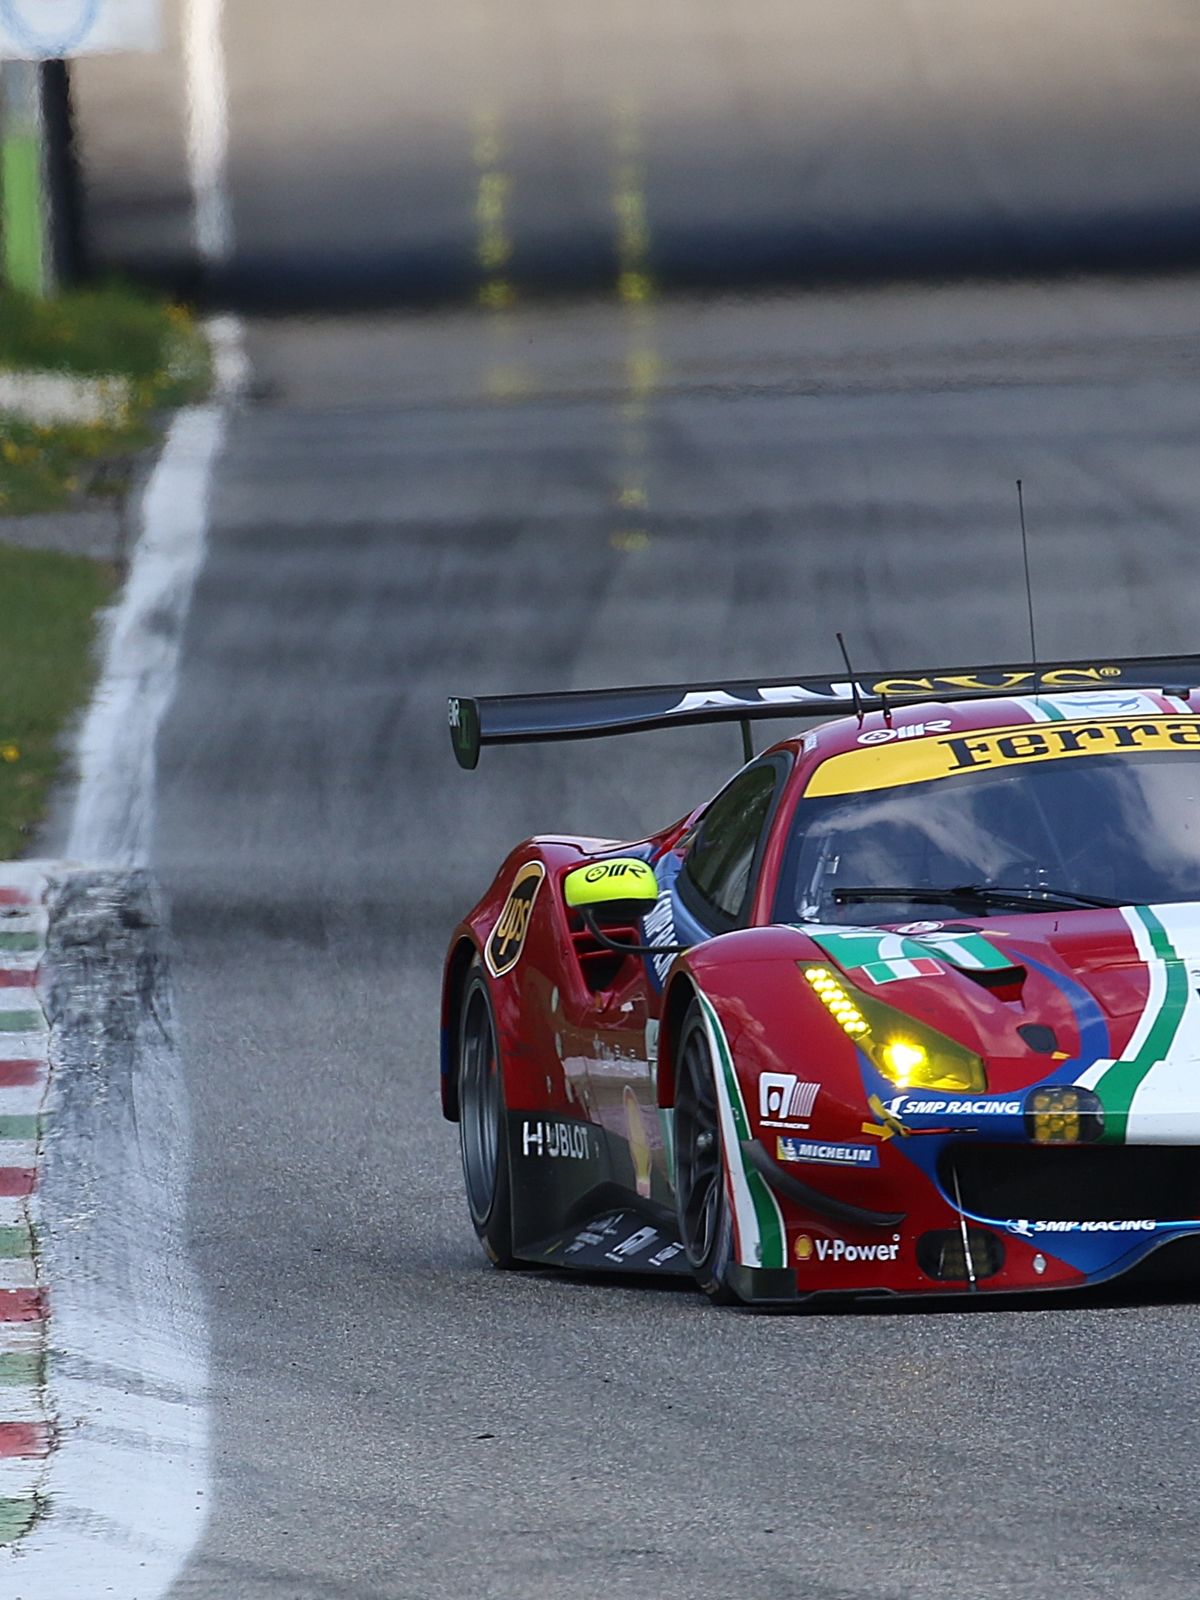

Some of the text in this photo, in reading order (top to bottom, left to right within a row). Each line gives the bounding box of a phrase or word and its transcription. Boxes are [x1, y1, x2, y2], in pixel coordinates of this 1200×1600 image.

[902, 1101, 1021, 1114] SMP RACING
[523, 1121, 590, 1160] HUBLOT
[798, 1144, 872, 1161] MICHELIN
[815, 1239, 900, 1262] V-Power
